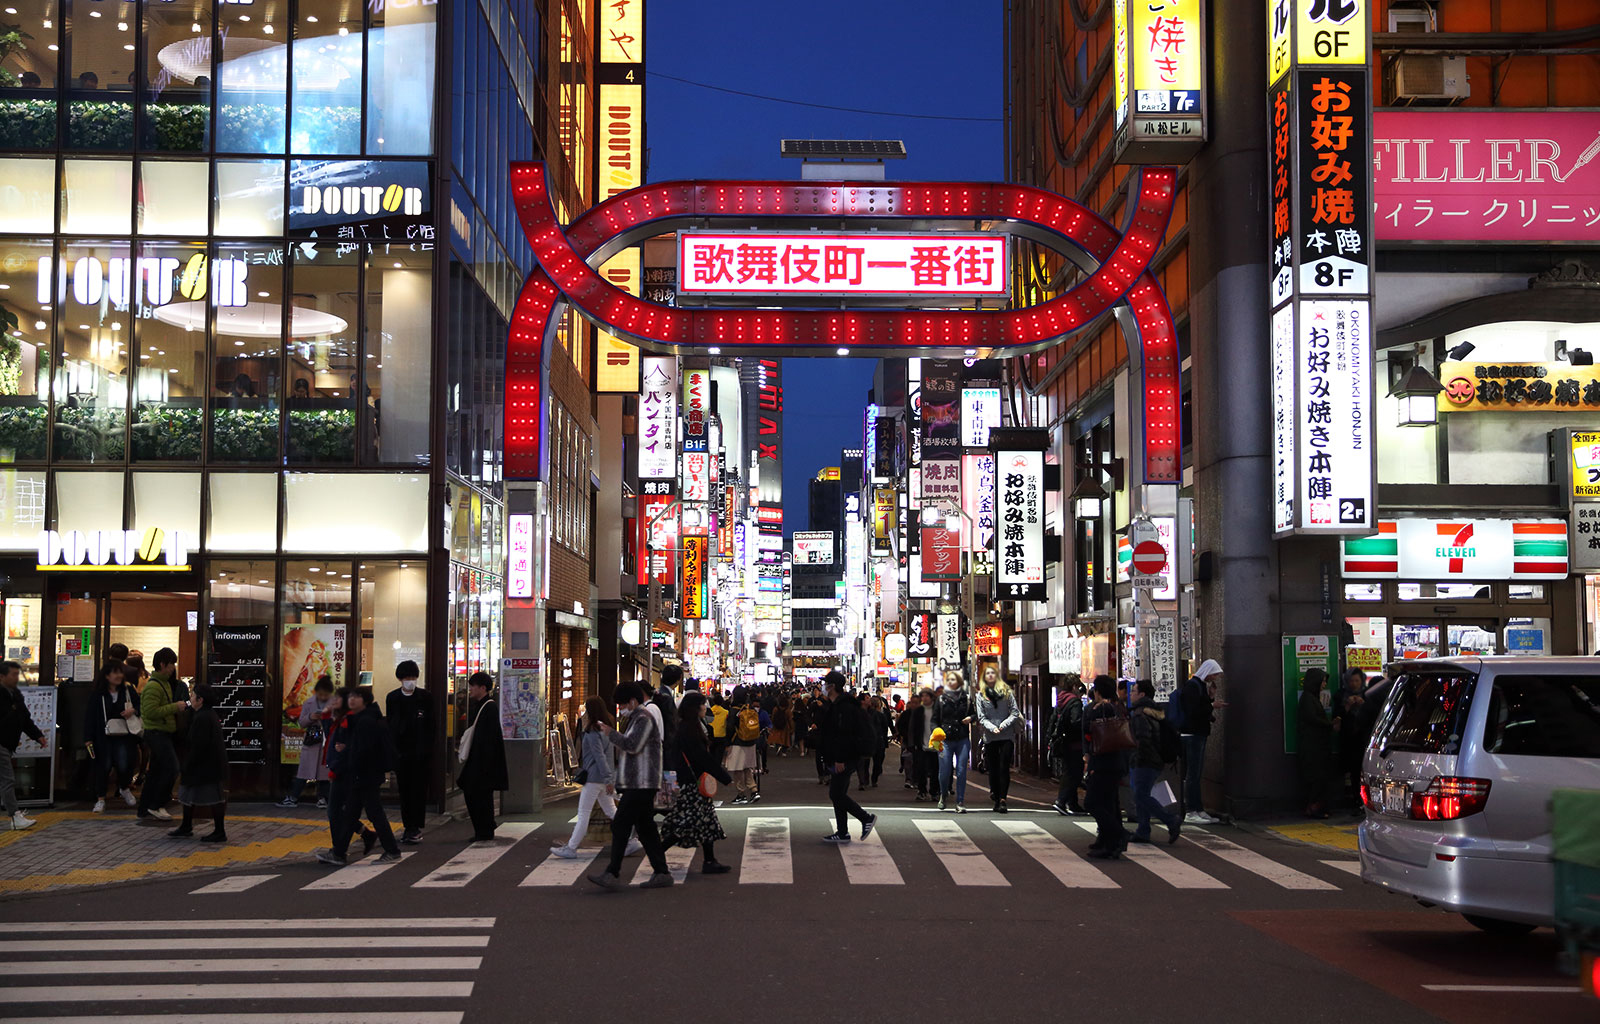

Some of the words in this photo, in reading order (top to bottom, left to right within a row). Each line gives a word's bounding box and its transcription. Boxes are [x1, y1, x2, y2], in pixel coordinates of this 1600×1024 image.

[1147, 0, 1186, 83] 焼き
[1314, 30, 1349, 57] 6F
[625, 70, 634, 82] 4
[1173, 91, 1194, 111] 7F
[1144, 122, 1191, 135] 小松ビル
[1311, 77, 1356, 224] お好み焼
[1274, 90, 1290, 239] お好み焼
[303, 184, 422, 215] DOUTOR
[1374, 200, 1469, 227] ィラー
[1306, 228, 1361, 255] 本陣
[693, 243, 994, 286] 歌舞伎町一番街
[1314, 262, 1354, 287] 8F
[1350, 310, 1361, 398] OKONOMIYAKI
[643, 391, 661, 454] バンタイ
[1307, 327, 1333, 501] お好み焼き本陣
[1352, 402, 1362, 450] HONJIN
[685, 439, 706, 450] B1F
[650, 468, 663, 476] 3F
[924, 463, 959, 481] 焼肉
[644, 482, 670, 494] 焼肉
[880, 512, 889, 536] 1
[1340, 501, 1364, 520] 2F
[514, 521, 528, 591] 劇場通り
[1009, 584, 1029, 595] 2F
[1134, 579, 1165, 587] 自転車を除く
[215, 632, 261, 640] information
[332, 629, 346, 693] 照り焼きでお
[1160, 624, 1170, 688] 防犯カメラ作動中
[1347, 648, 1381, 656] ATM
